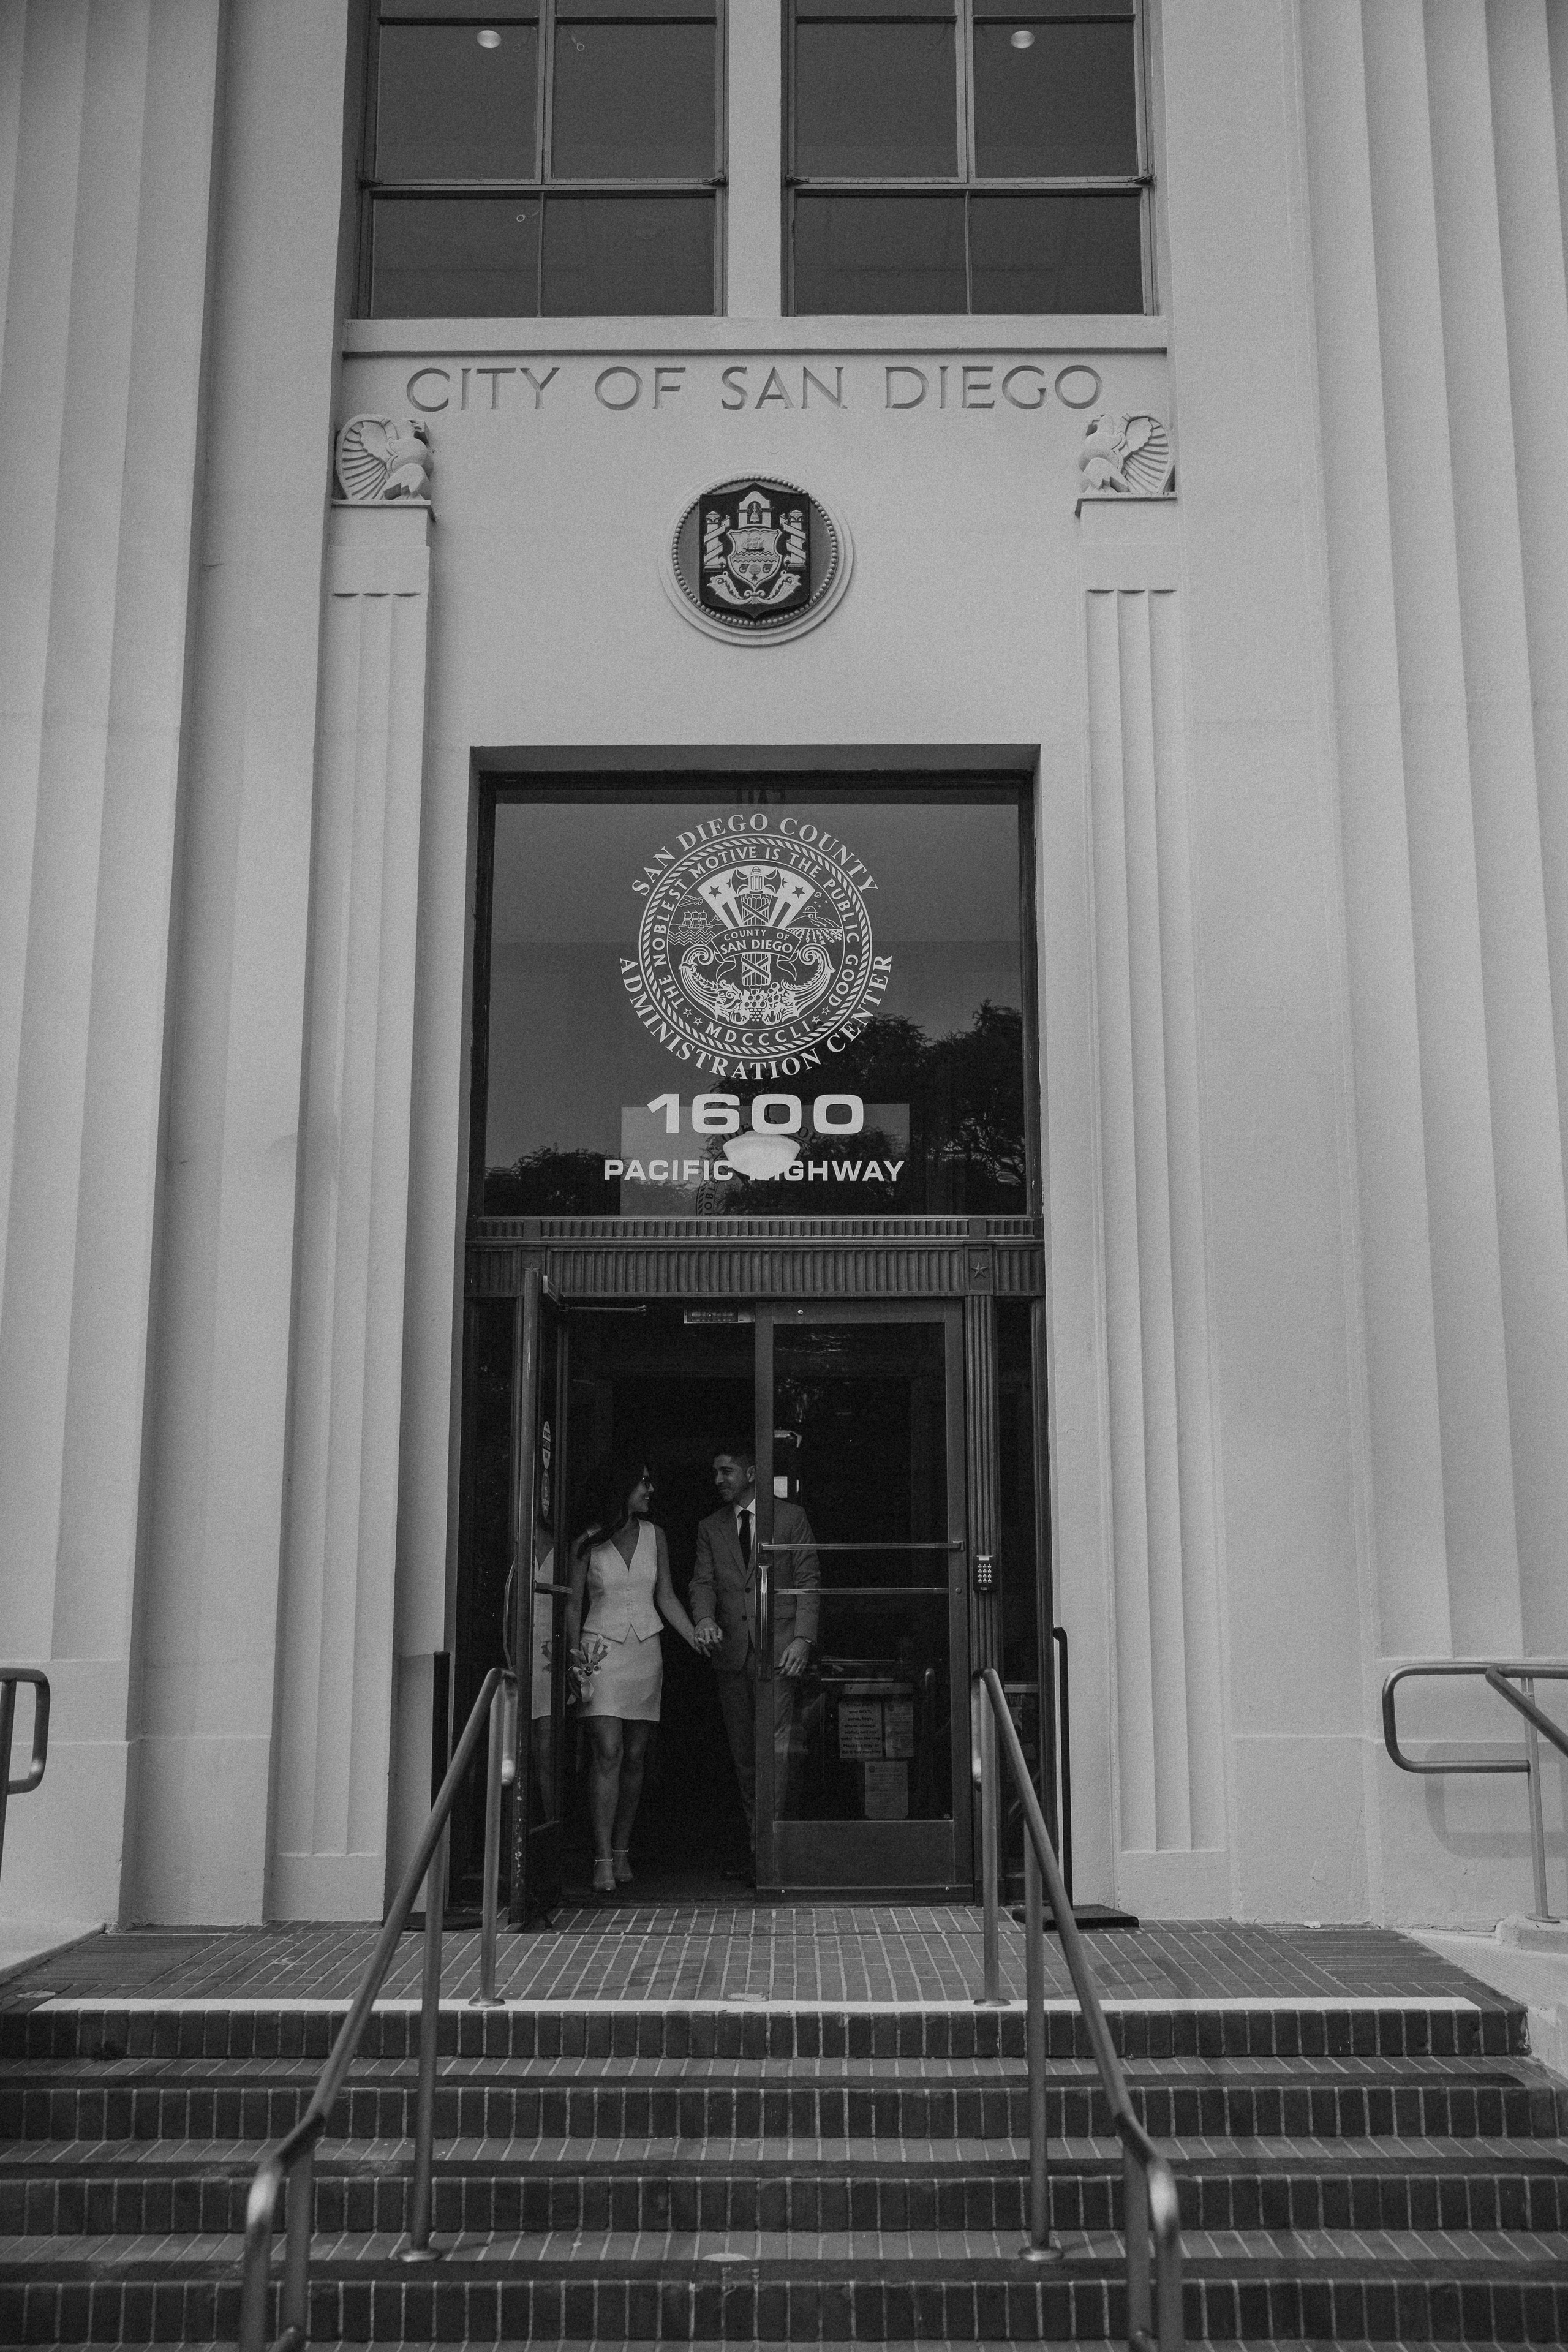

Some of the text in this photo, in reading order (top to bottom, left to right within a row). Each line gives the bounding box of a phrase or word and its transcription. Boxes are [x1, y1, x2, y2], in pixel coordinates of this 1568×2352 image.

[407, 364, 1102, 412] CITY OF SAN DIEGO
[631, 813, 879, 896] SAN DIEGO COUNTY
[652, 846, 860, 1009] THE NOBLEST MOTIVE IS THE PUBLIC GOOD
[720, 939, 793, 955] SAN DIEGO
[723, 929, 790, 941] COUNTY OF
[619, 956, 892, 1080] ADMINISTRATION CENTER
[704, 1020, 811, 1046] MDCCCLI
[647, 1093, 864, 1134] 1600
[605, 1159, 905, 1181] PACIFIC GHWAY
